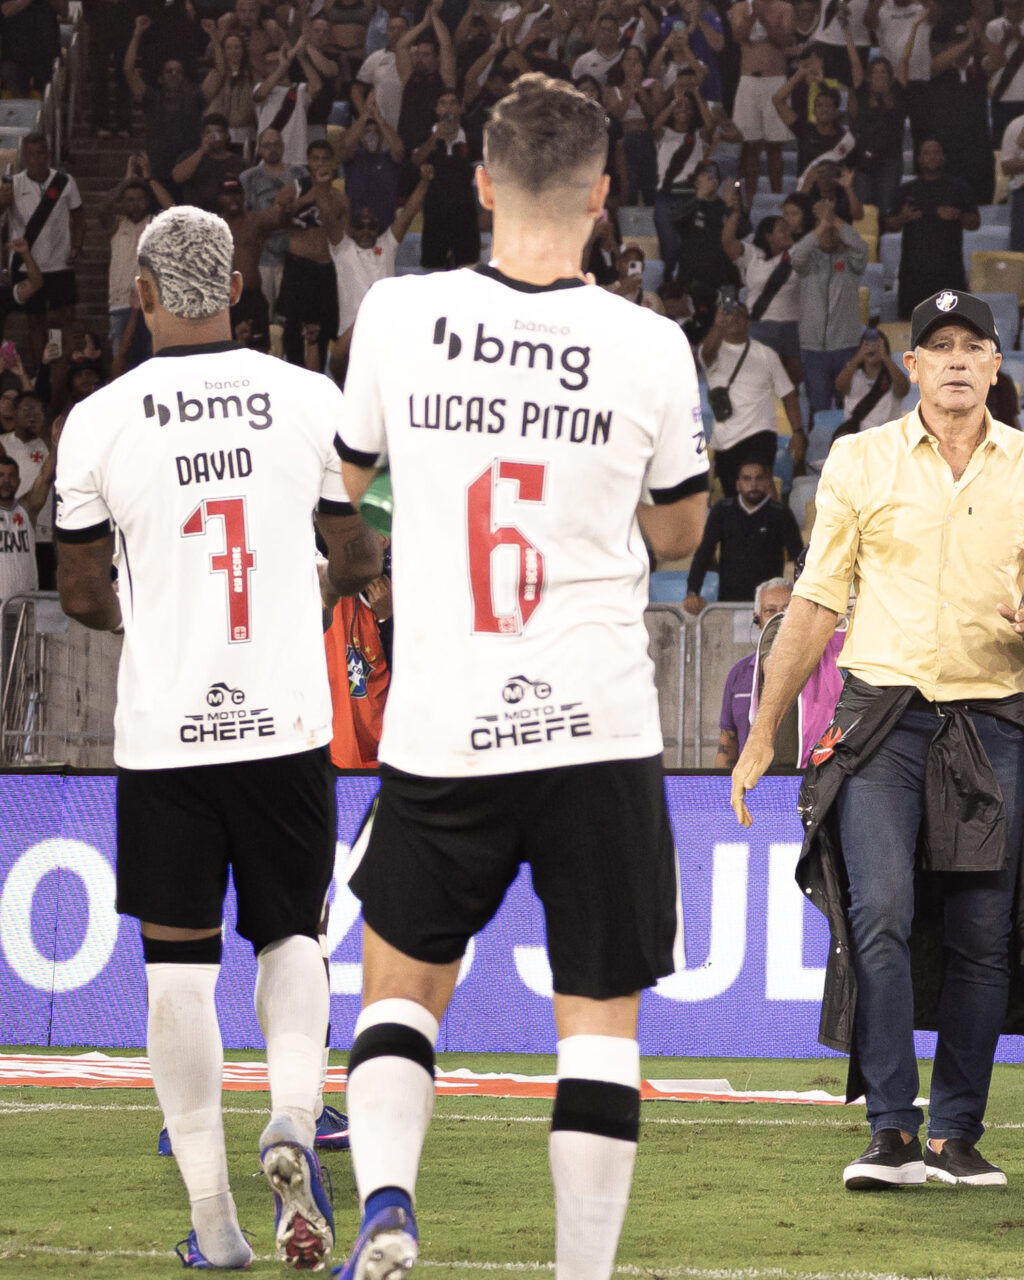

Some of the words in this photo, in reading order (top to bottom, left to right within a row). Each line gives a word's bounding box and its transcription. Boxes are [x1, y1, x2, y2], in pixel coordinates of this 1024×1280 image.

[473, 322, 591, 391] bmg
[204, 378, 251, 390] banco
[176, 390, 273, 430] bmg
[409, 393, 506, 434] LUCAS
[520, 401, 613, 445] PITON
[175, 447, 253, 487] DAVID
[465, 456, 549, 636] 6
[180, 495, 257, 645] 7
[179, 716, 276, 743] CHEFE
[207, 709, 247, 721] MOTO
[470, 713, 592, 751] CHEFE
[504, 704, 554, 720] MOTO
